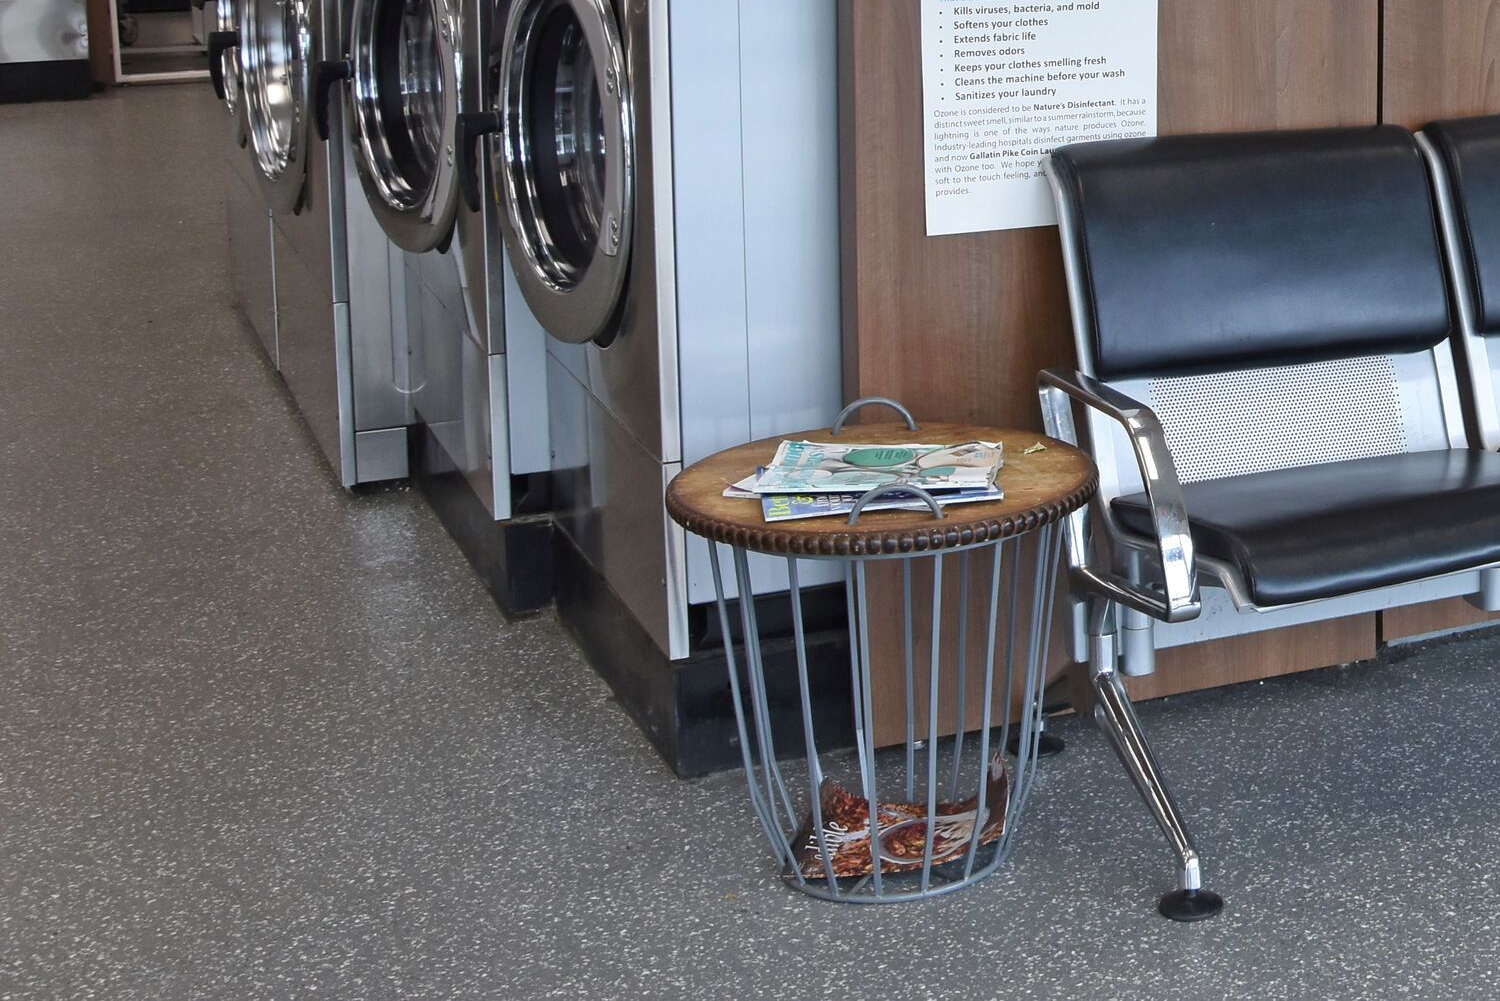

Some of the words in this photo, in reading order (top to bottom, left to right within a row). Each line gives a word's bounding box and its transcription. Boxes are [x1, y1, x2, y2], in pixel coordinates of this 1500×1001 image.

[953, 6, 973, 15] Kills
[974, 5, 1011, 14] viruses,
[1013, 3, 1054, 12] bacteria,
[1056, 2, 1074, 11] and
[1076, 1, 1100, 10] mold
[953, 20, 989, 29] Softens
[990, 20, 1013, 30] your
[1014, 17, 1048, 26] clothes
[953, 33, 990, 43] Extends
[992, 32, 1019, 41] fabric
[1021, 31, 1036, 40] life
[954, 49, 996, 57] Removes
[998, 46, 1025, 55] odors
[954, 63, 982, 73] Keeps
[984, 62, 1006, 72] your
[1007, 59, 1041, 69] clothes
[1043, 57, 1081, 67] smelling
[1083, 56, 1106, 65] fresh
[954, 77, 985, 86] Cleans
[987, 75, 1003, 84] the
[1005, 73, 1044, 83] machine
[1046, 72, 1076, 81] before
[1078, 71, 1100, 81] your
[1101, 68, 1125, 78] wash
[954, 90, 996, 100] Sanitizes
[997, 90, 1019, 100] your
[1021, 86, 1056, 96] laundry
[933, 109, 958, 117] Ozone
[968, 104, 1010, 115] considered
[1033, 102, 1065, 110] Nature's
[1067, 99, 1116, 108] Disinfectant.
[933, 120, 962, 128] distinct
[963, 118, 985, 126] sweet
[1008, 115, 1033, 124] similar
[1047, 113, 1078, 121] summer
[933, 131, 969, 141] lightning
[1014, 126, 1028, 134] the
[1031, 126, 1050, 134] ways
[1082, 121, 1119, 132] produces
[998, 137, 1032, 146] hospitals
[1033, 135, 1064, 144] disinfect
[1066, 133, 1101, 143] garments
[1123, 130, 1146, 138] ozone
[934, 154, 949, 162] and
[969, 150, 1000, 159] Gallatin
[1020, 148, 1038, 156] Coin
[934, 165, 952, 173] with
[954, 164, 979, 172] Ozone
[1014, 158, 1036, 169] hope
[934, 176, 949, 185] soft
[978, 172, 1000, 181] touch
